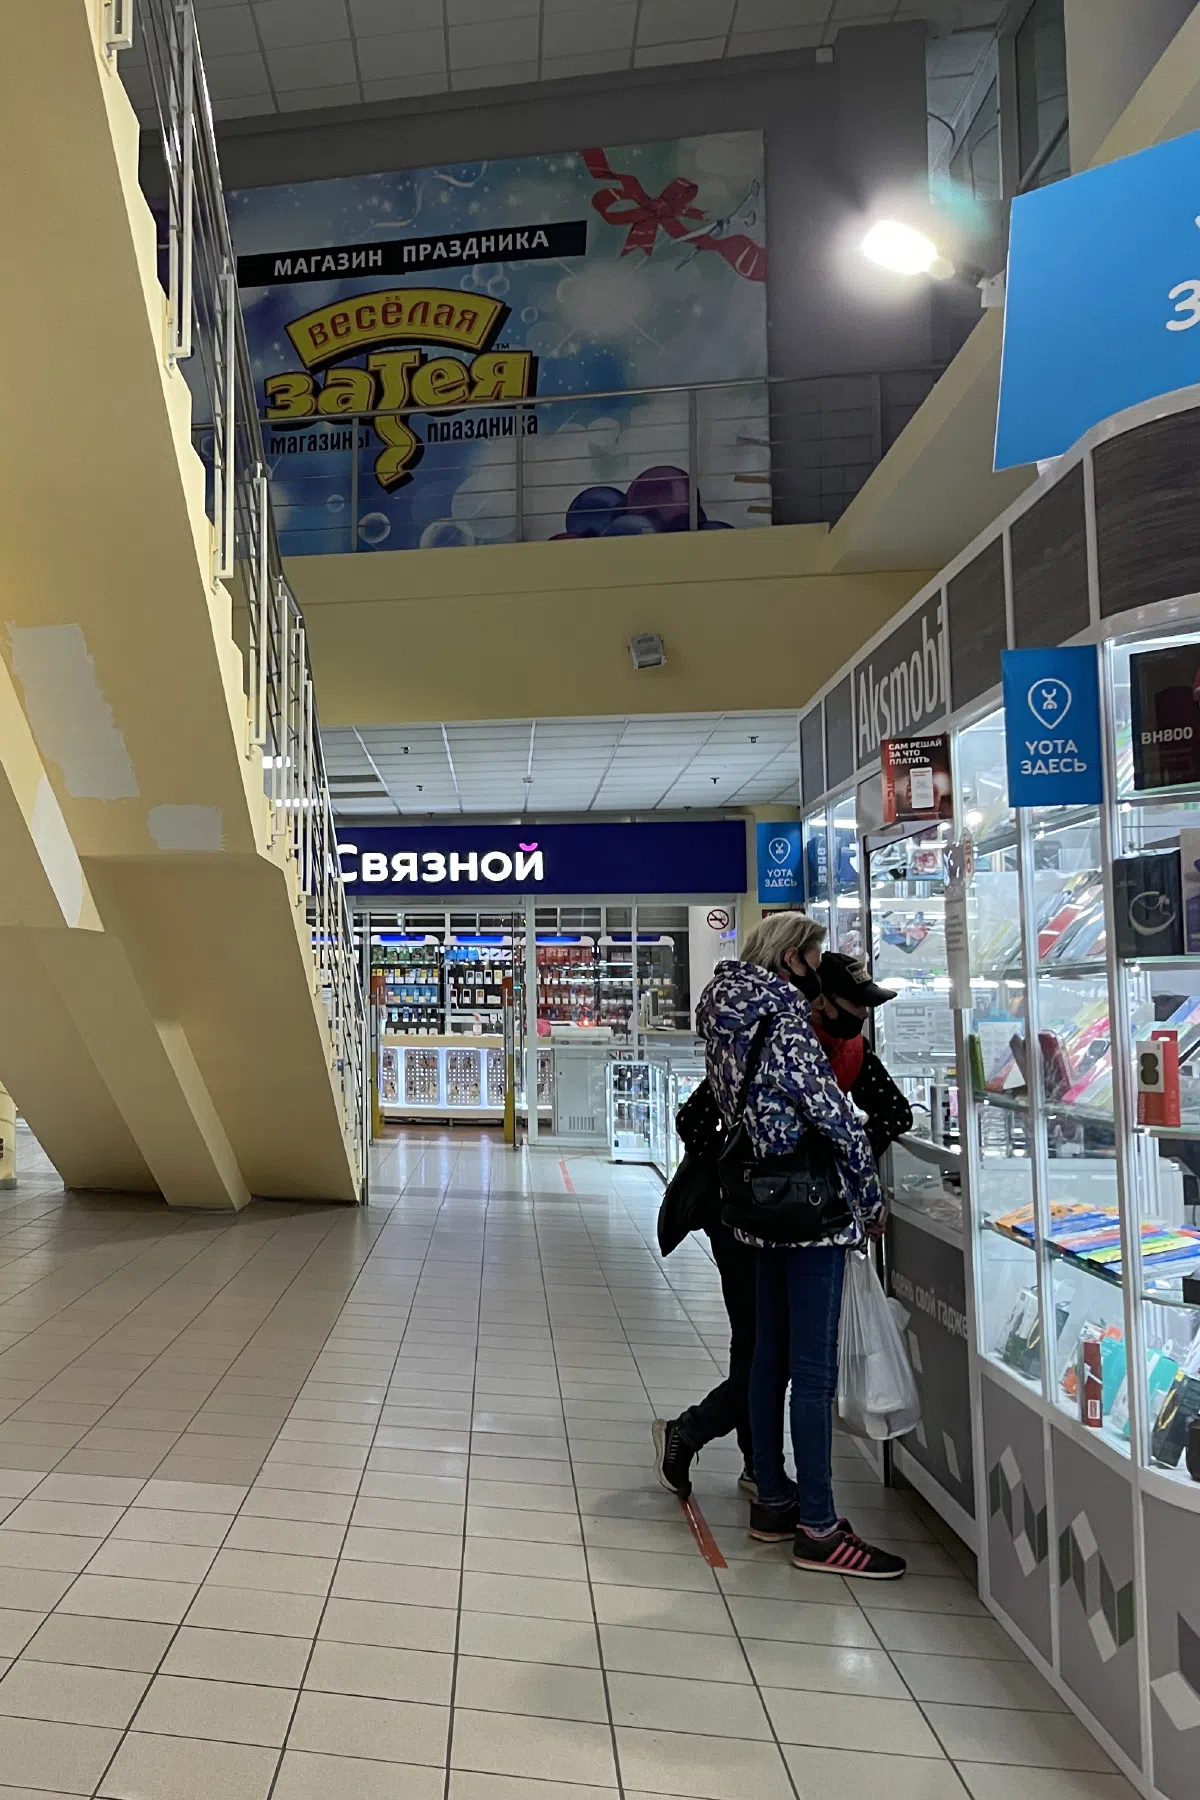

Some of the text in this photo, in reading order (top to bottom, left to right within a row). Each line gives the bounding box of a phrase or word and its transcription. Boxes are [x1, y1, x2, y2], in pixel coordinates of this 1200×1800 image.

[274, 230, 549, 277] МАГАЗИН ПРАЗДНИКА
[858, 605, 943, 758] Aksmobi
[1141, 726, 1193, 745] BH800
[910, 738, 942, 748] РЕШАЙ
[1025, 739, 1079, 756] YOTA
[902, 749, 920, 757] ЧТО
[889, 756, 930, 766] ПЛАТИТЬ
[1020, 758, 1087, 776] ЗДЕСЬ
[766, 869, 793, 877] YOTA
[764, 878, 798, 888] ЗДЕСЬ
